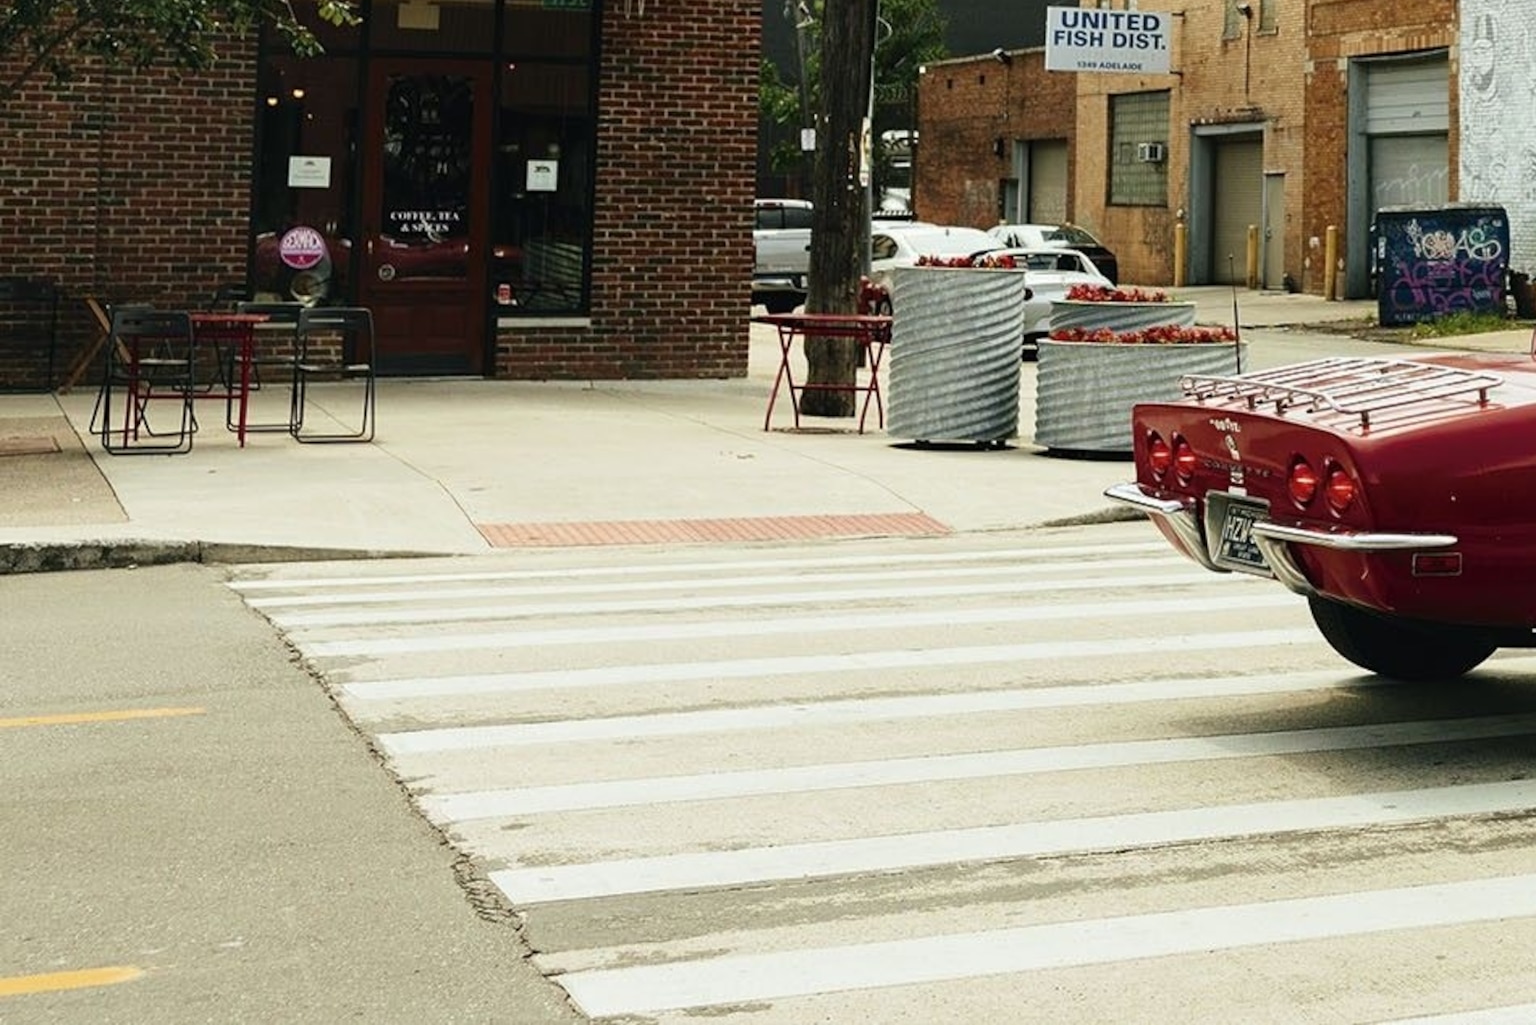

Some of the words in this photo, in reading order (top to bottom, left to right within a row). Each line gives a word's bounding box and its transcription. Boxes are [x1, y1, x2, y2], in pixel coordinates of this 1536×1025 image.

[1061, 11, 1160, 32] UNITED
[1053, 30, 1103, 48] FISH
[1112, 33, 1166, 50] DIST.
[1099, 62, 1142, 70] ADELAIDE
[439, 211, 459, 221] TEA
[400, 224, 409, 232] &
